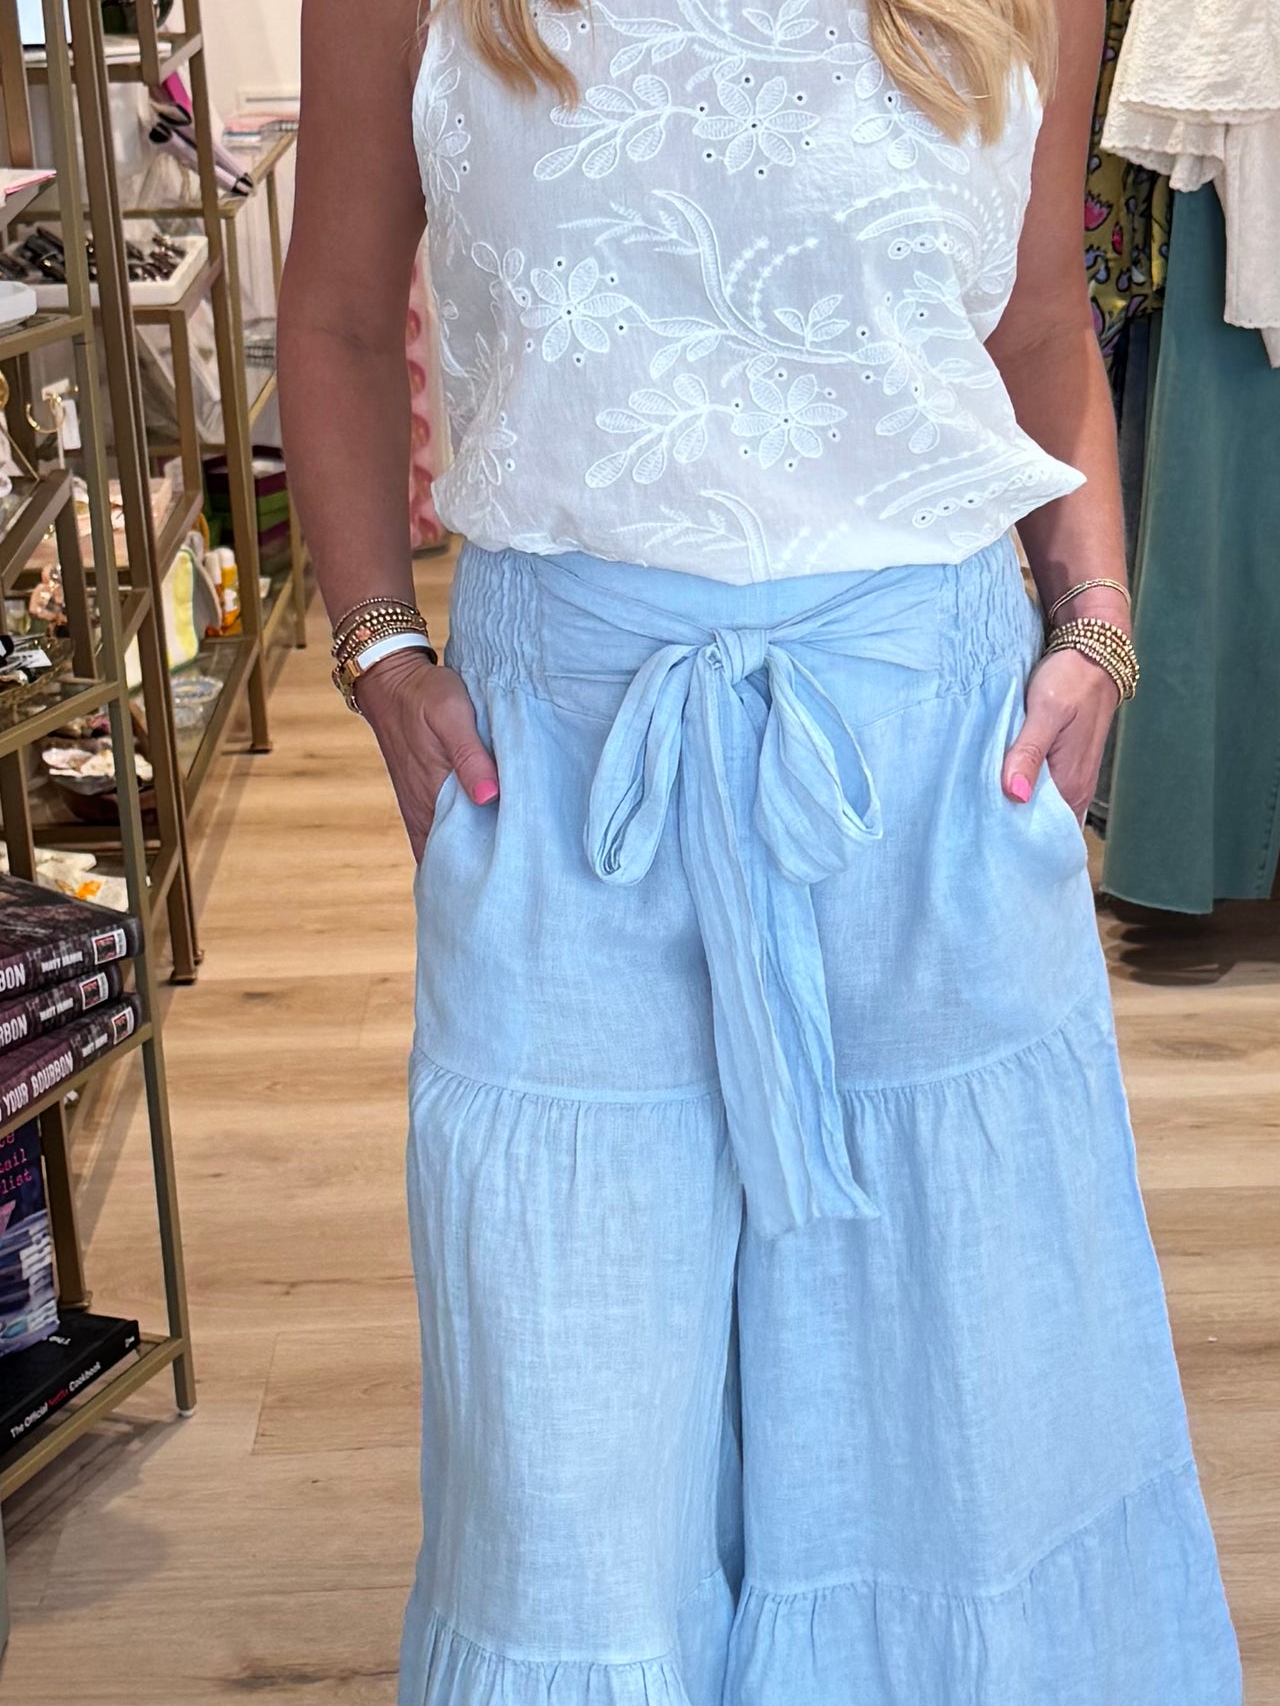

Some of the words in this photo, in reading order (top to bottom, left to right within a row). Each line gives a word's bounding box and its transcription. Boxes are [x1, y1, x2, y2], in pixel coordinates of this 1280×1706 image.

[2, 1083, 29, 1116] YOUR
[32, 1051, 74, 1097] BOURBON
[10, 1424, 25, 1438] The
